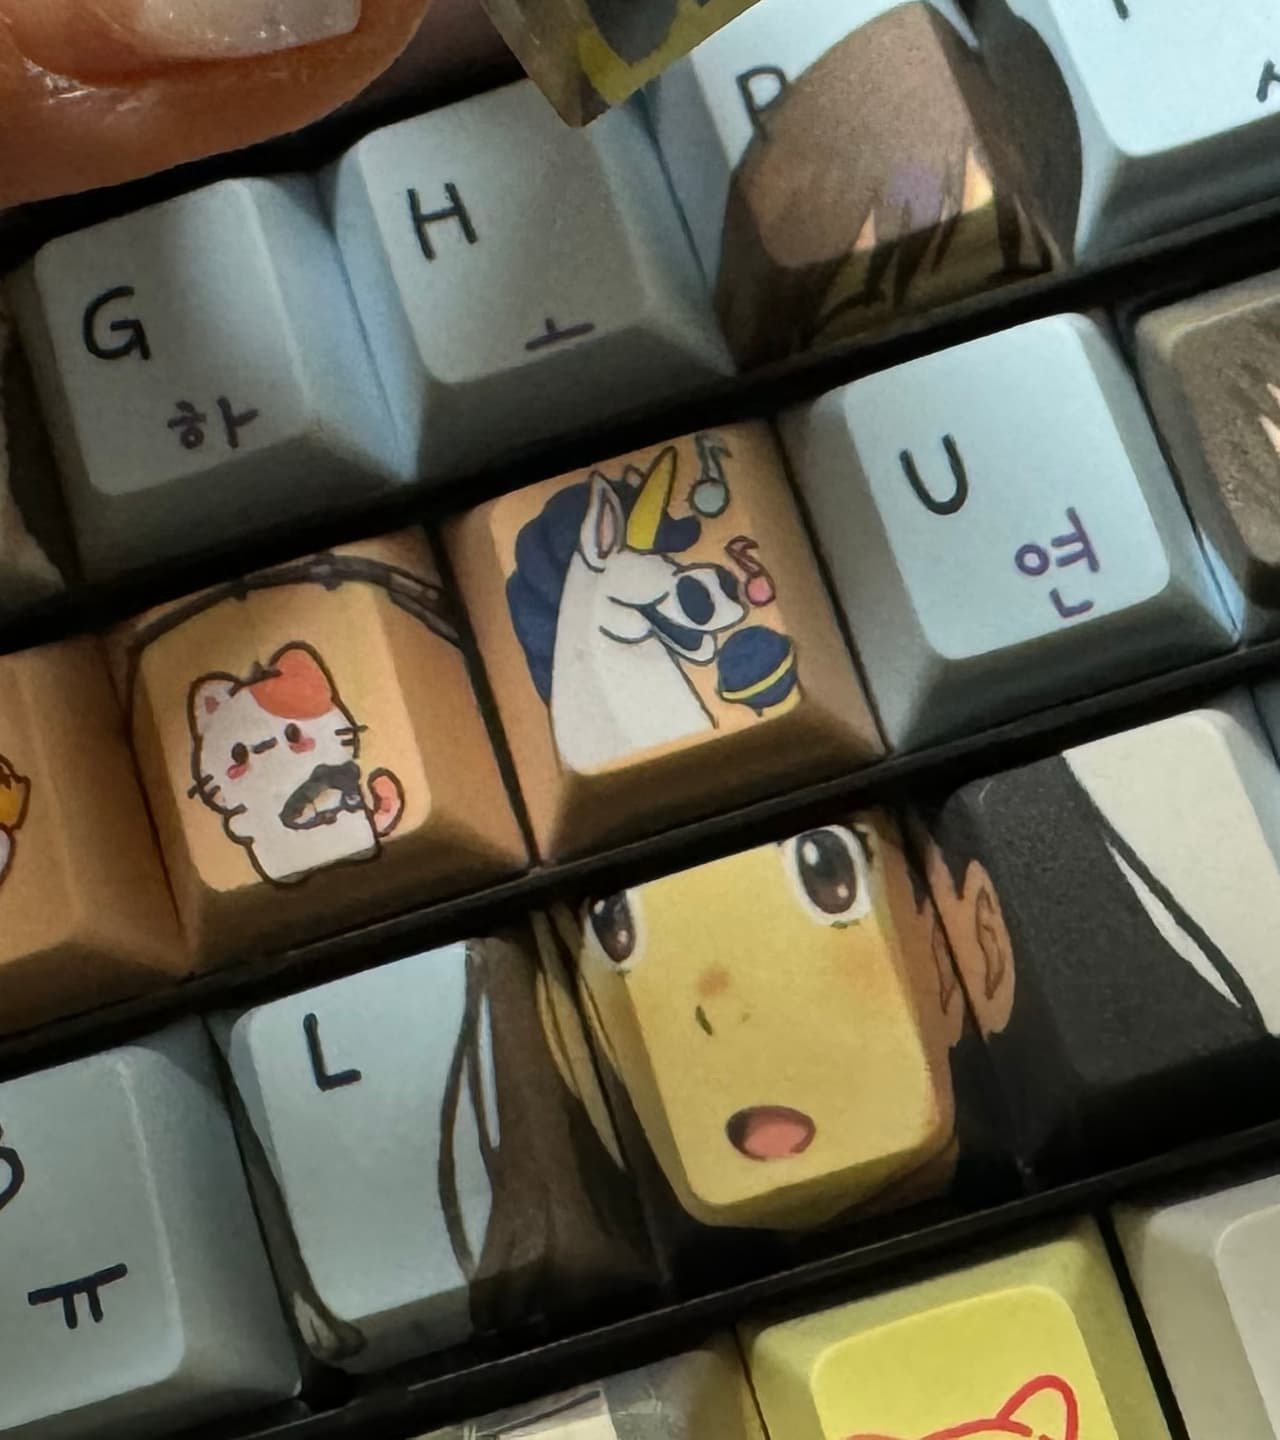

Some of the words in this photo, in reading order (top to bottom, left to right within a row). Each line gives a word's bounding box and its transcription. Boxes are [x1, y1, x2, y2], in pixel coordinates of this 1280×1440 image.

[406, 182, 479, 262] H
[82, 285, 152, 361] G
[898, 434, 969, 516] U
[1013, 506, 1100, 619] 연
[302, 1012, 362, 1093] L
